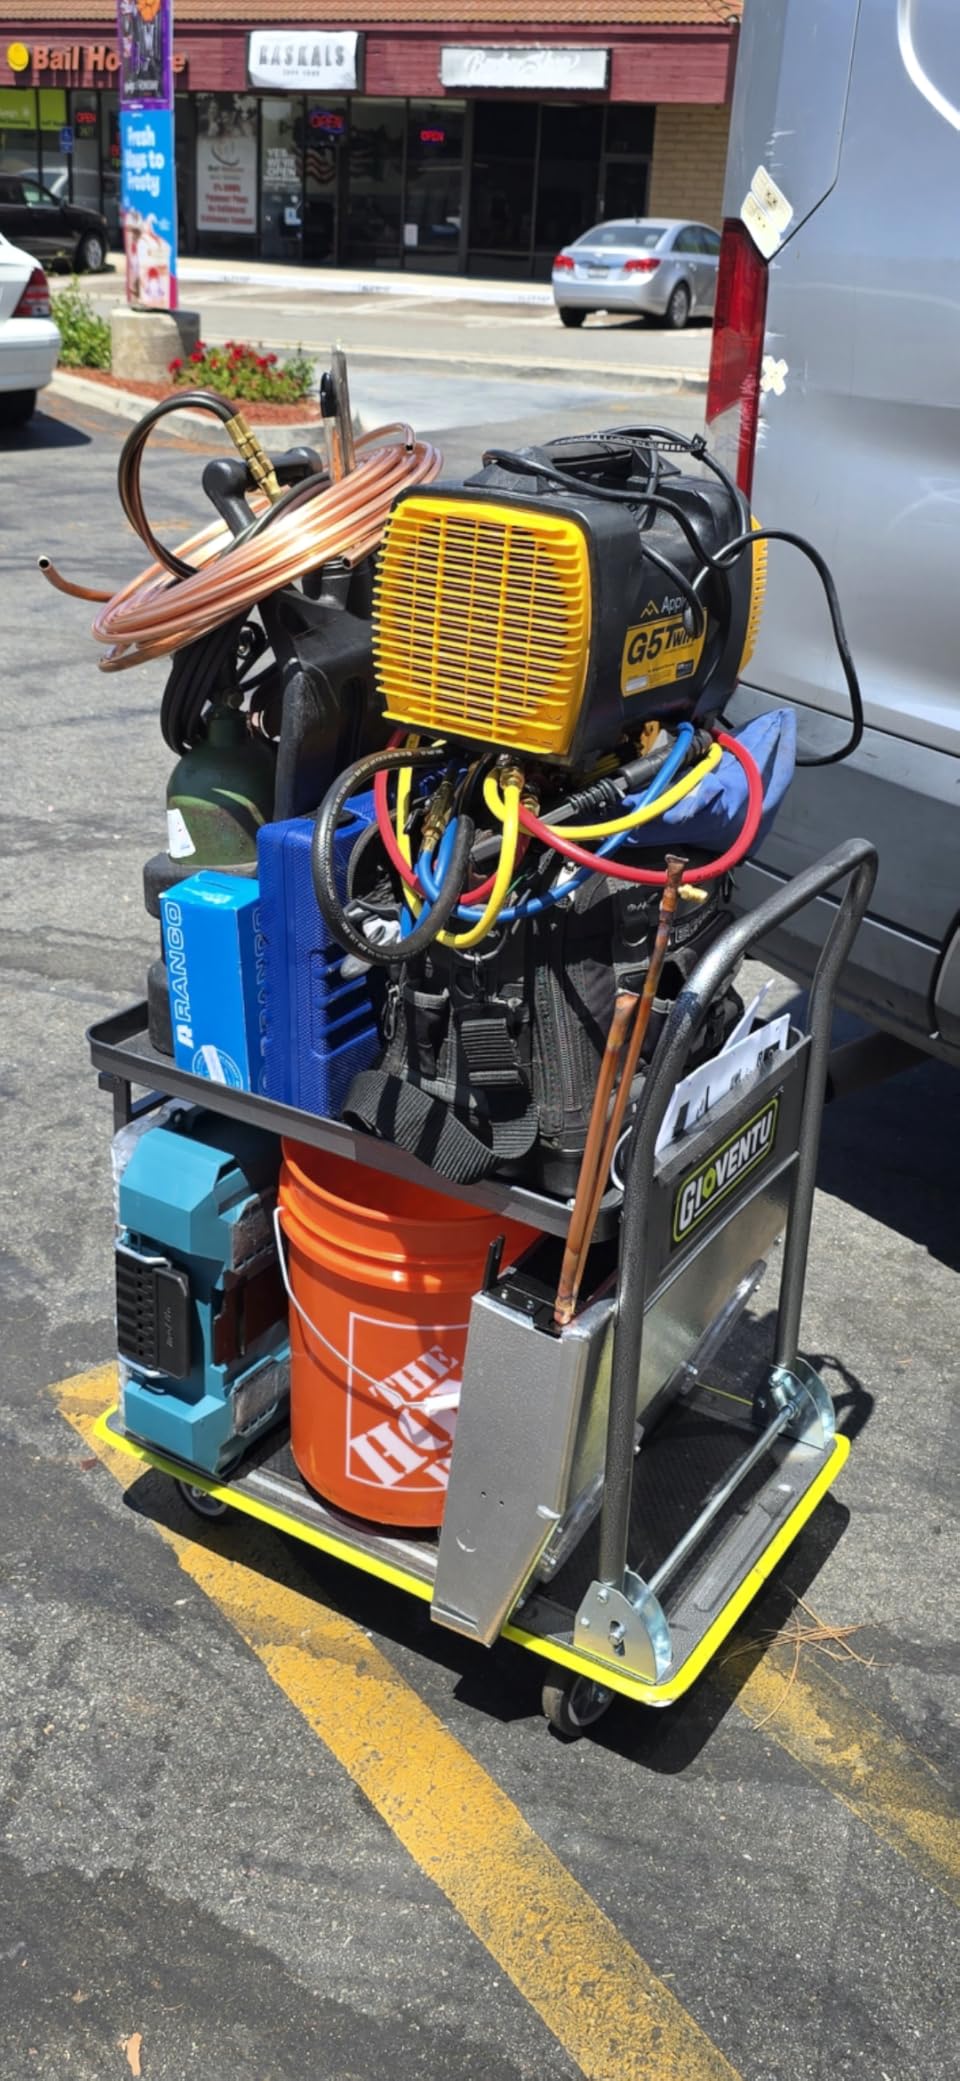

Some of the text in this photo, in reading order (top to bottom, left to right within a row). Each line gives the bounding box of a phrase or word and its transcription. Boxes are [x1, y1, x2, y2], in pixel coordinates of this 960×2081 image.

[33, 45, 79, 70] Bail
[75, 112, 97, 123] OPEN
[310, 114, 343, 129] OPEN
[420, 130, 445, 142] OPEN
[148, 150, 165, 170] to
[165, 901, 192, 1023] RANCO
[679, 1110, 773, 1232] GIOVENTU
[368, 1345, 459, 1410] THE
